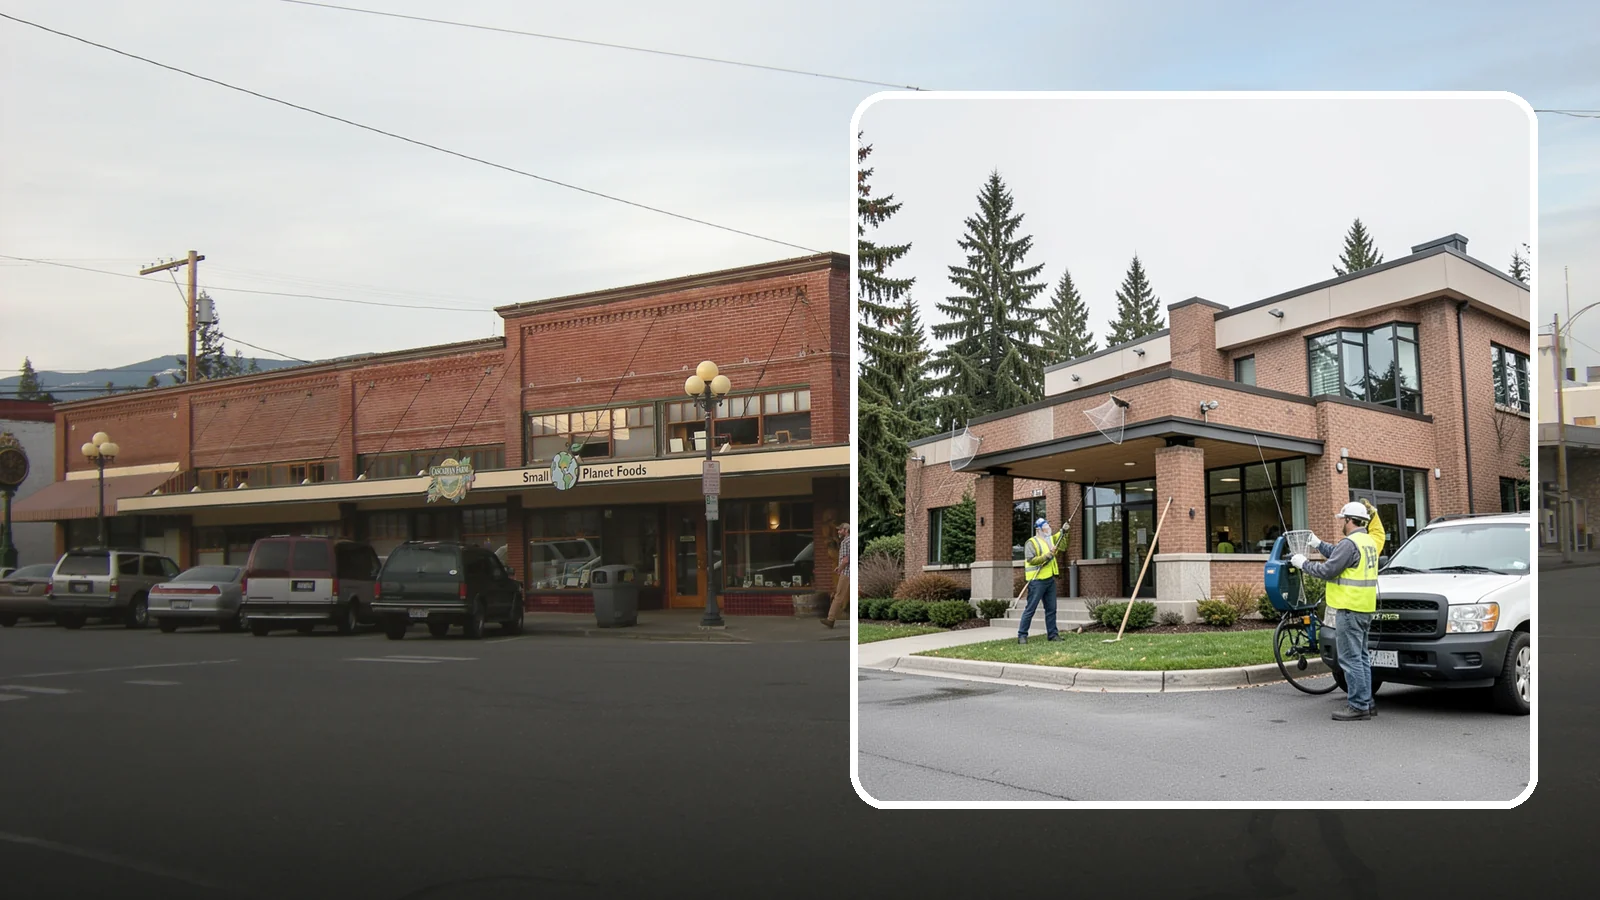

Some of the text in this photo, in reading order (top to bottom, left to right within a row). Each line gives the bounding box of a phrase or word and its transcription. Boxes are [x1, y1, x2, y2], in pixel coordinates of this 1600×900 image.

[523, 464, 647, 483] Small Planet Foods
